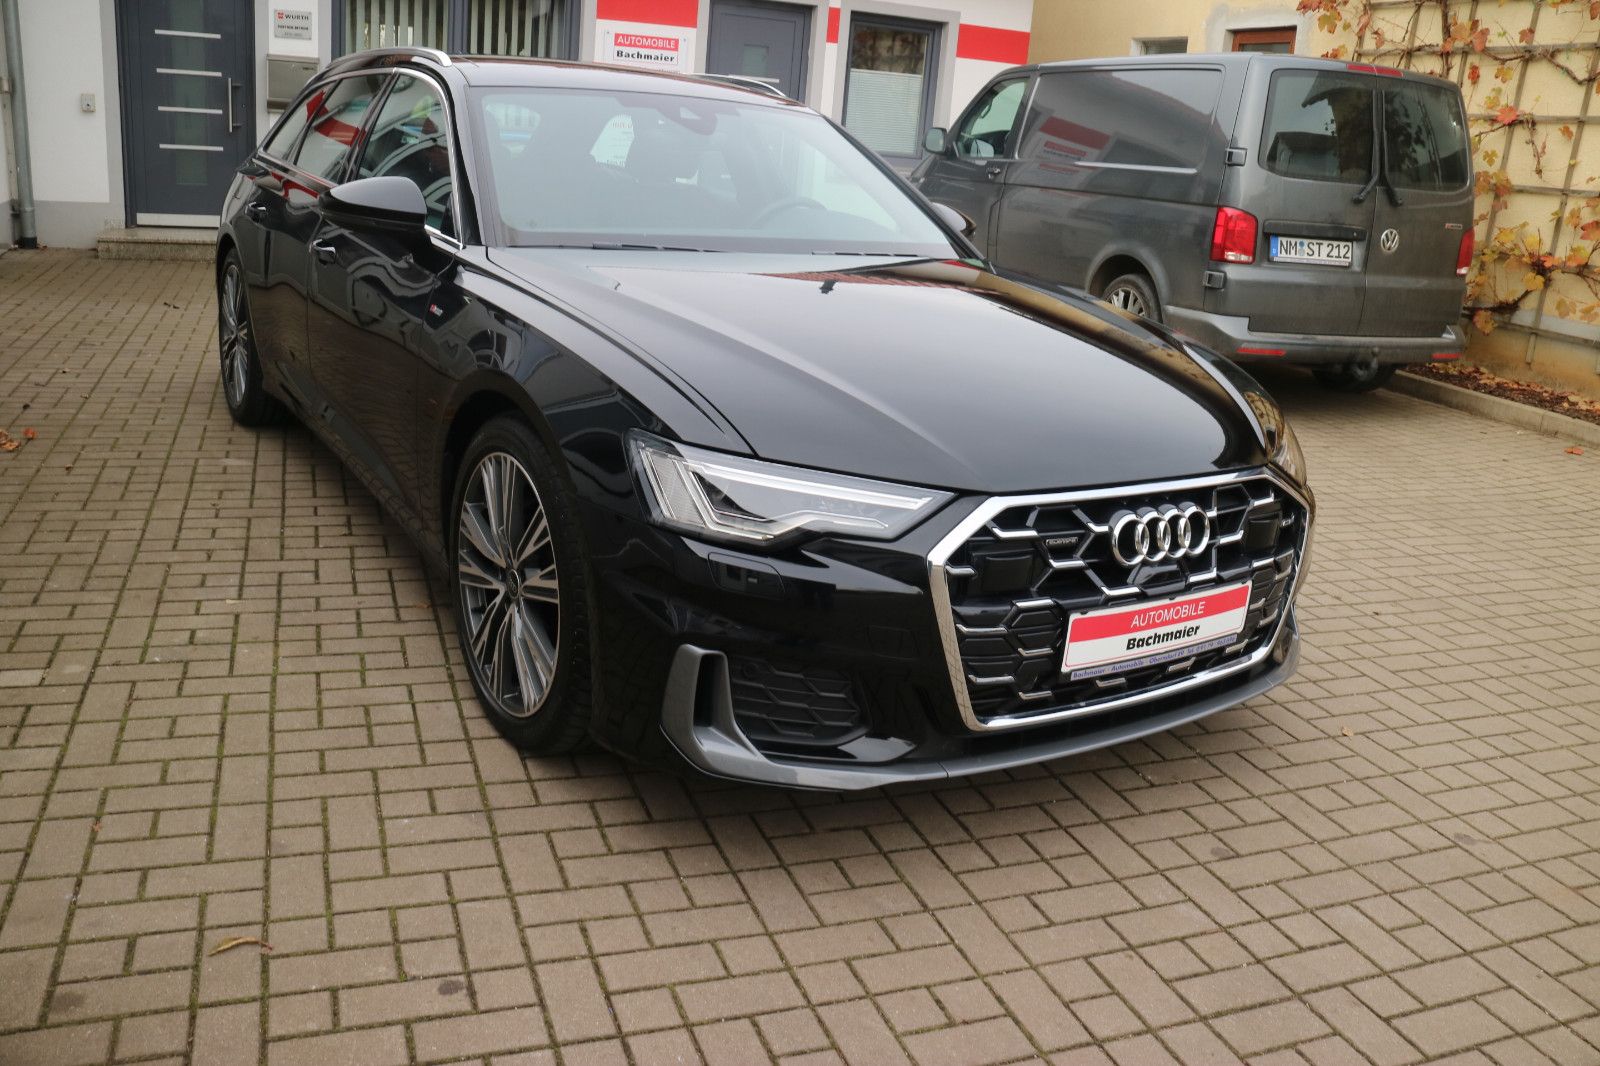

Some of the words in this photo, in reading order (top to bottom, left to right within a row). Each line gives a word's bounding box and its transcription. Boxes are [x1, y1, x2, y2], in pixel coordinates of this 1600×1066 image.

[617, 35, 675, 48] AUTOMOBILE
[616, 50, 675, 62] Bachmaier
[1279, 240, 1298, 256] NM
[1306, 241, 1324, 257] ST
[1326, 243, 1351, 259] 212
[1130, 601, 1206, 628] AUTOMOBILE
[1125, 624, 1201, 651] Bachmaier
